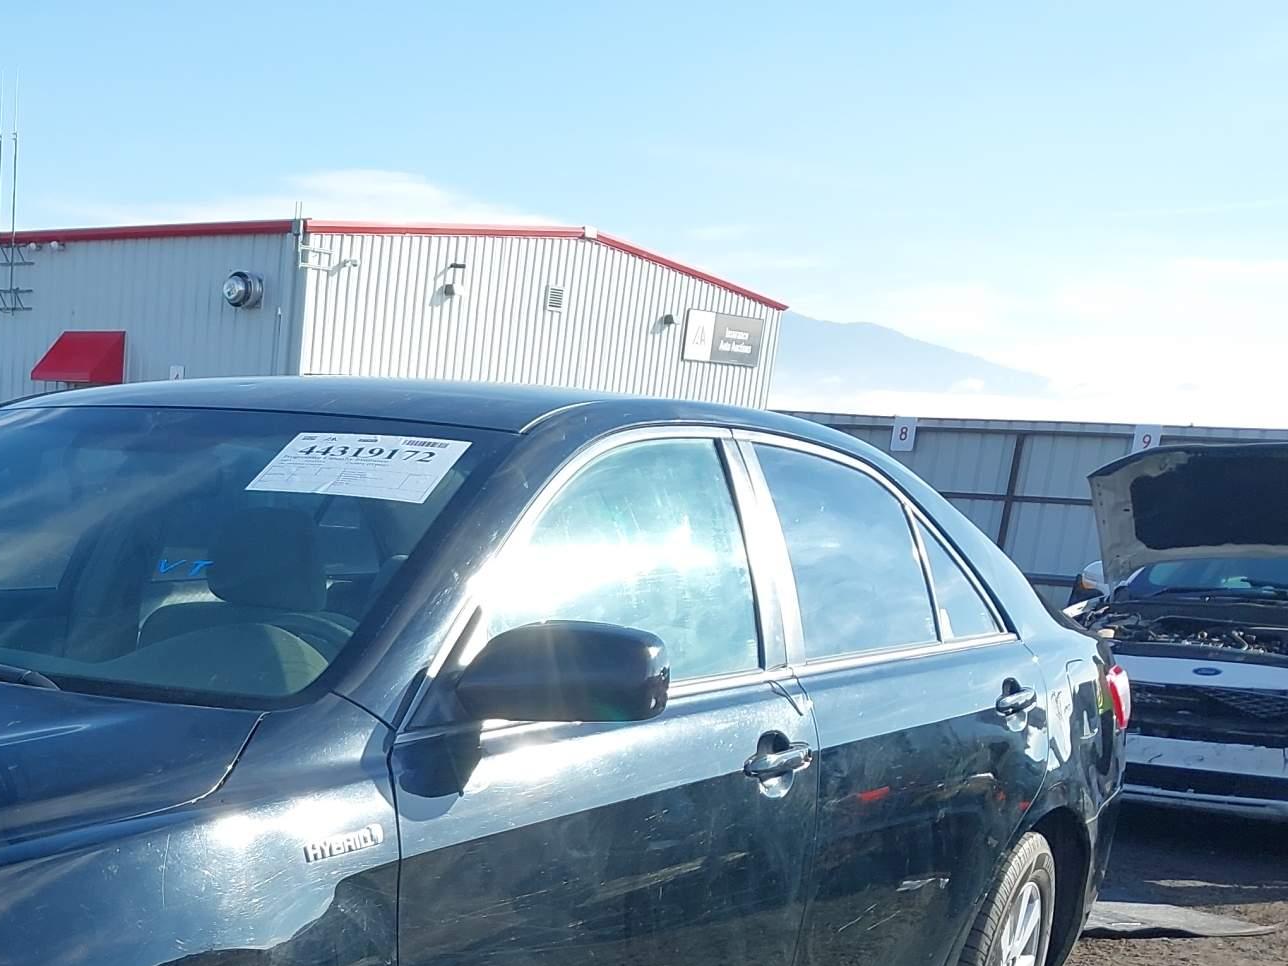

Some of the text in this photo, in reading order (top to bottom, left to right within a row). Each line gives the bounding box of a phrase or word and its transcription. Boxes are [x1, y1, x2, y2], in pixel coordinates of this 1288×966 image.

[899, 426, 908, 441] 8
[1142, 433, 1152, 449] 9
[298, 444, 439, 464] 44319172
[303, 826, 376, 864] HYBRID
